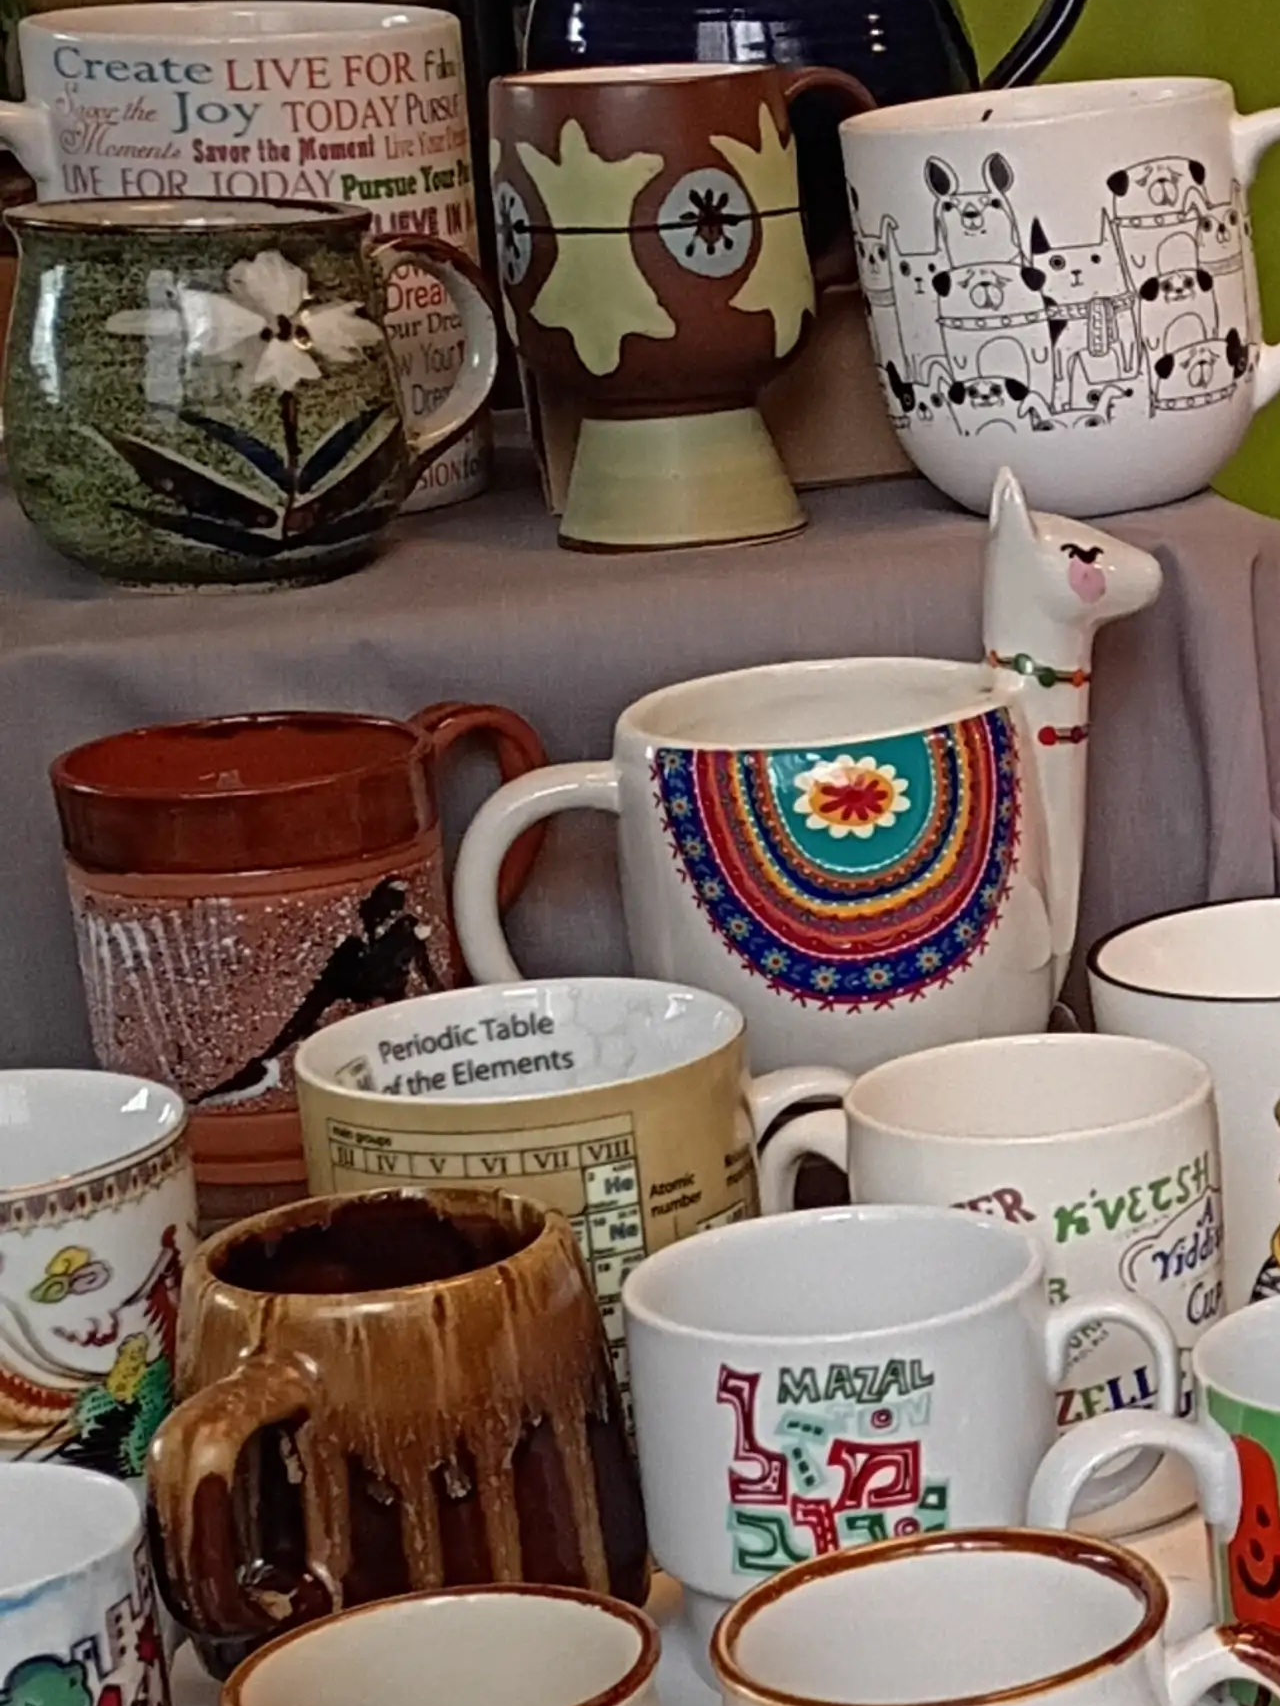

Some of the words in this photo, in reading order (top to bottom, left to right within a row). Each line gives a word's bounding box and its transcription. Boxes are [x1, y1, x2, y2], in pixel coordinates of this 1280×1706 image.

[53, 45, 213, 84] Create
[225, 56, 331, 91] LIVE
[342, 51, 416, 87] FOR
[122, 95, 158, 123] the
[172, 91, 263, 137] Joy
[282, 95, 401, 133] TODAY
[192, 138, 251, 164] Savor
[257, 137, 291, 163] the
[297, 133, 376, 166] Moment
[63, 164, 102, 196] LIVE
[121, 167, 188, 198] FOR
[209, 169, 336, 199] TODAY
[341, 172, 417, 201] Pursue
[386, 281, 447, 314] Drea
[378, 1024, 478, 1065] Periodic
[479, 1011, 554, 1042] Table
[381, 1075, 402, 1096] of
[405, 1070, 447, 1097] the
[452, 1049, 575, 1087] Elements
[376, 1154, 399, 1173] IV
[428, 1156, 446, 1174] V
[480, 1156, 508, 1174] VI
[533, 1150, 570, 1170] VII
[587, 1139, 632, 1163] VIII
[649, 1170, 696, 1200] Atomic
[650, 1191, 703, 1218] number
[777, 1358, 935, 1405] MAZAL
